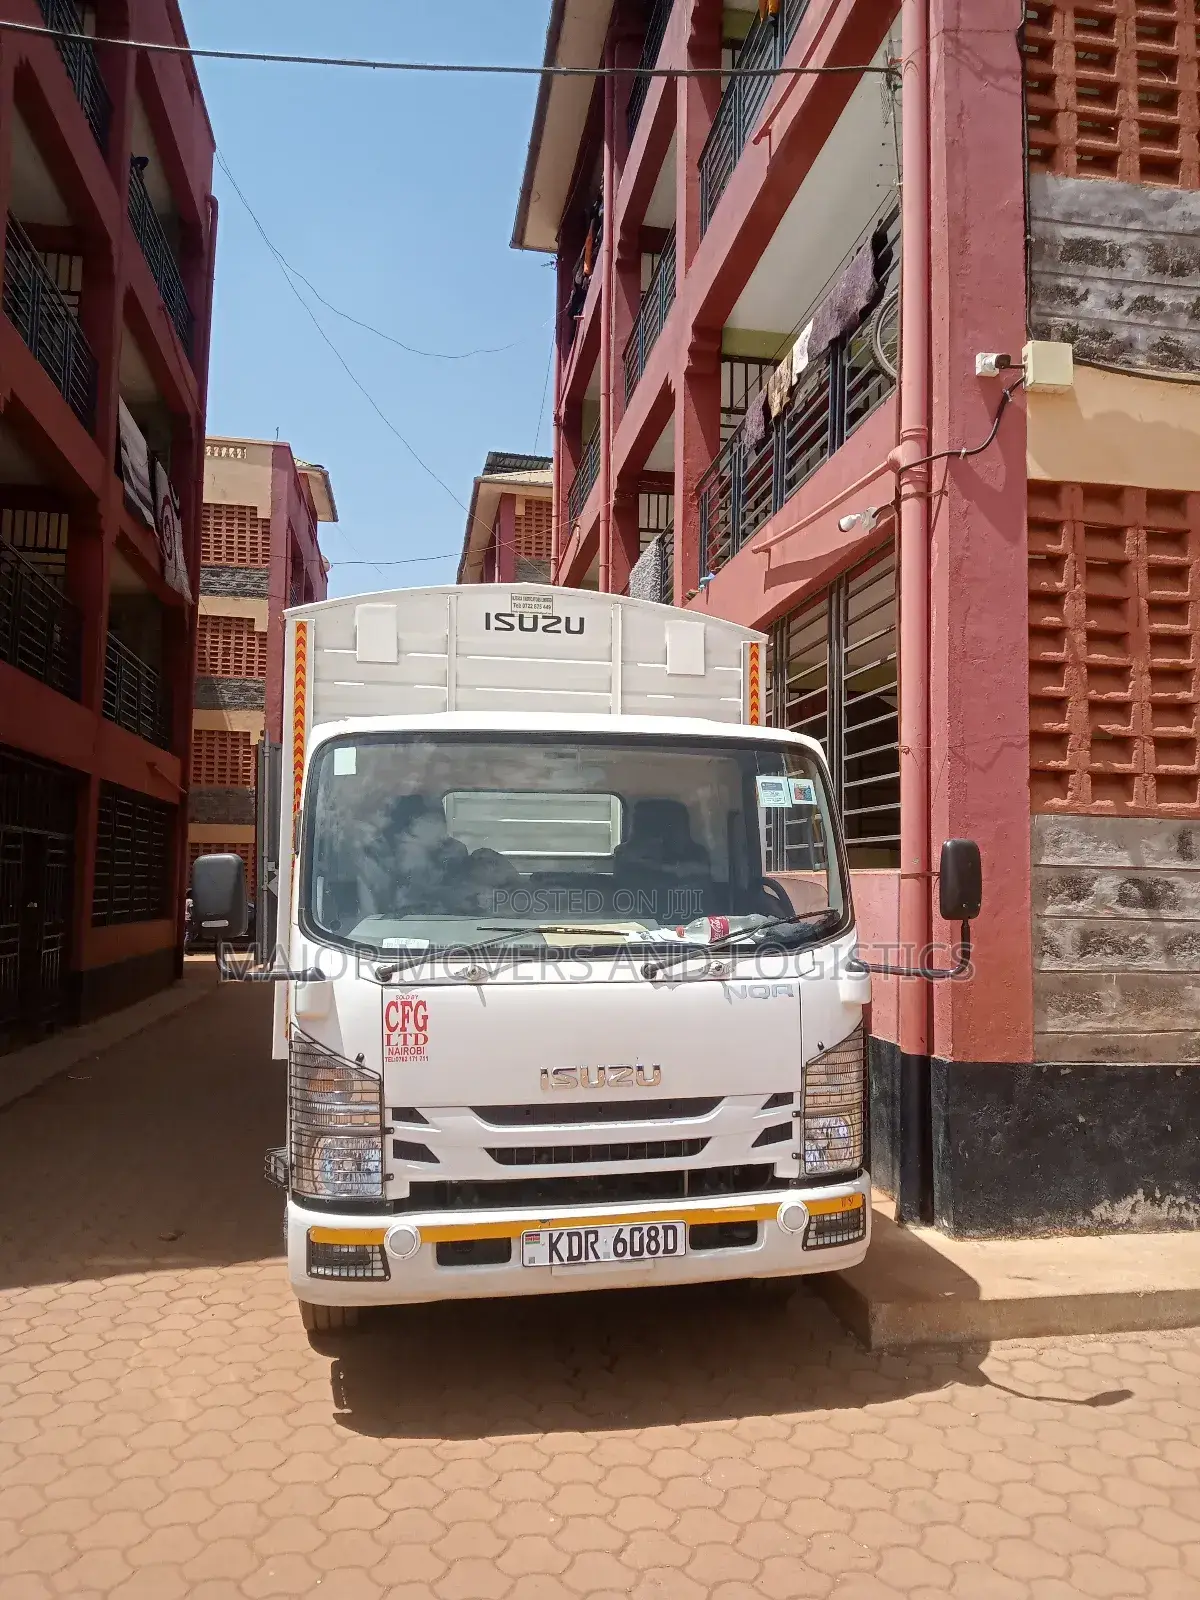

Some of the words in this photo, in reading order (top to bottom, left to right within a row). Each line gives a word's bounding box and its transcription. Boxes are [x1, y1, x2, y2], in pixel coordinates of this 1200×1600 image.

[485, 612, 585, 635] ISUZU
[723, 984, 794, 1000] NQR
[384, 1000, 429, 1033] CFG
[384, 1032, 429, 1047] LTD
[387, 1046, 425, 1056] NAIROBI
[540, 1063, 661, 1091] ISUZU
[548, 1229, 600, 1262] KDR
[612, 1224, 678, 1258] 608D
